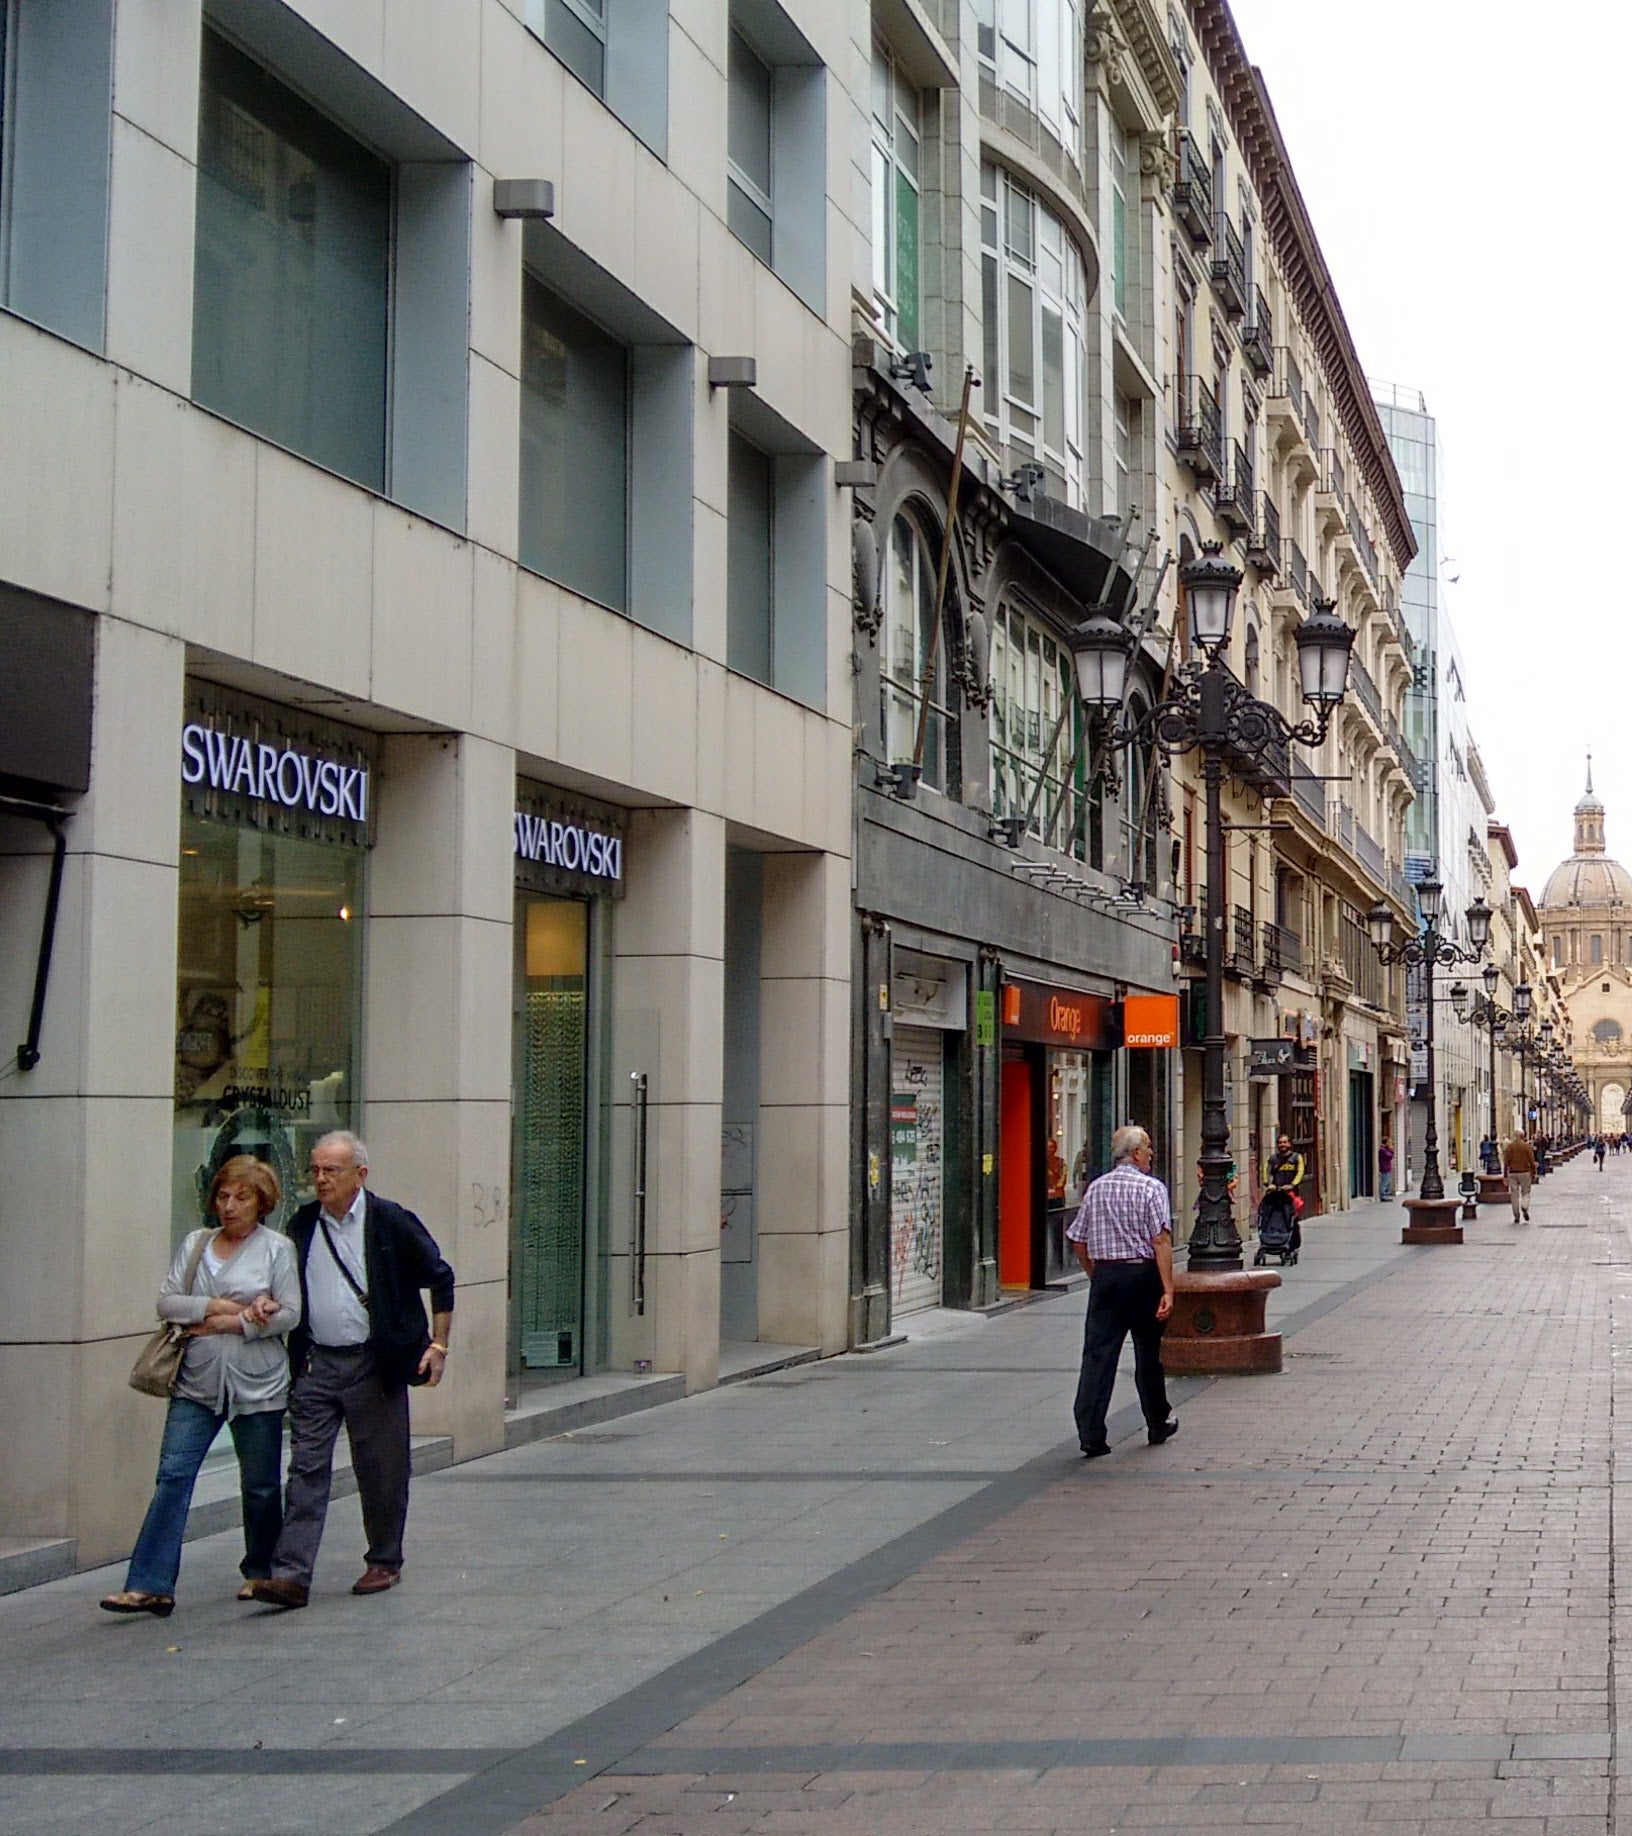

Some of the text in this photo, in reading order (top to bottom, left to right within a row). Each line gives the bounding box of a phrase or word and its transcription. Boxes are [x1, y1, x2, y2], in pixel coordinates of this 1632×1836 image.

[182, 724, 368, 822] SWAROVSKI
[1050, 995, 1081, 1041] Orange
[1127, 1033, 1171, 1045] orange
